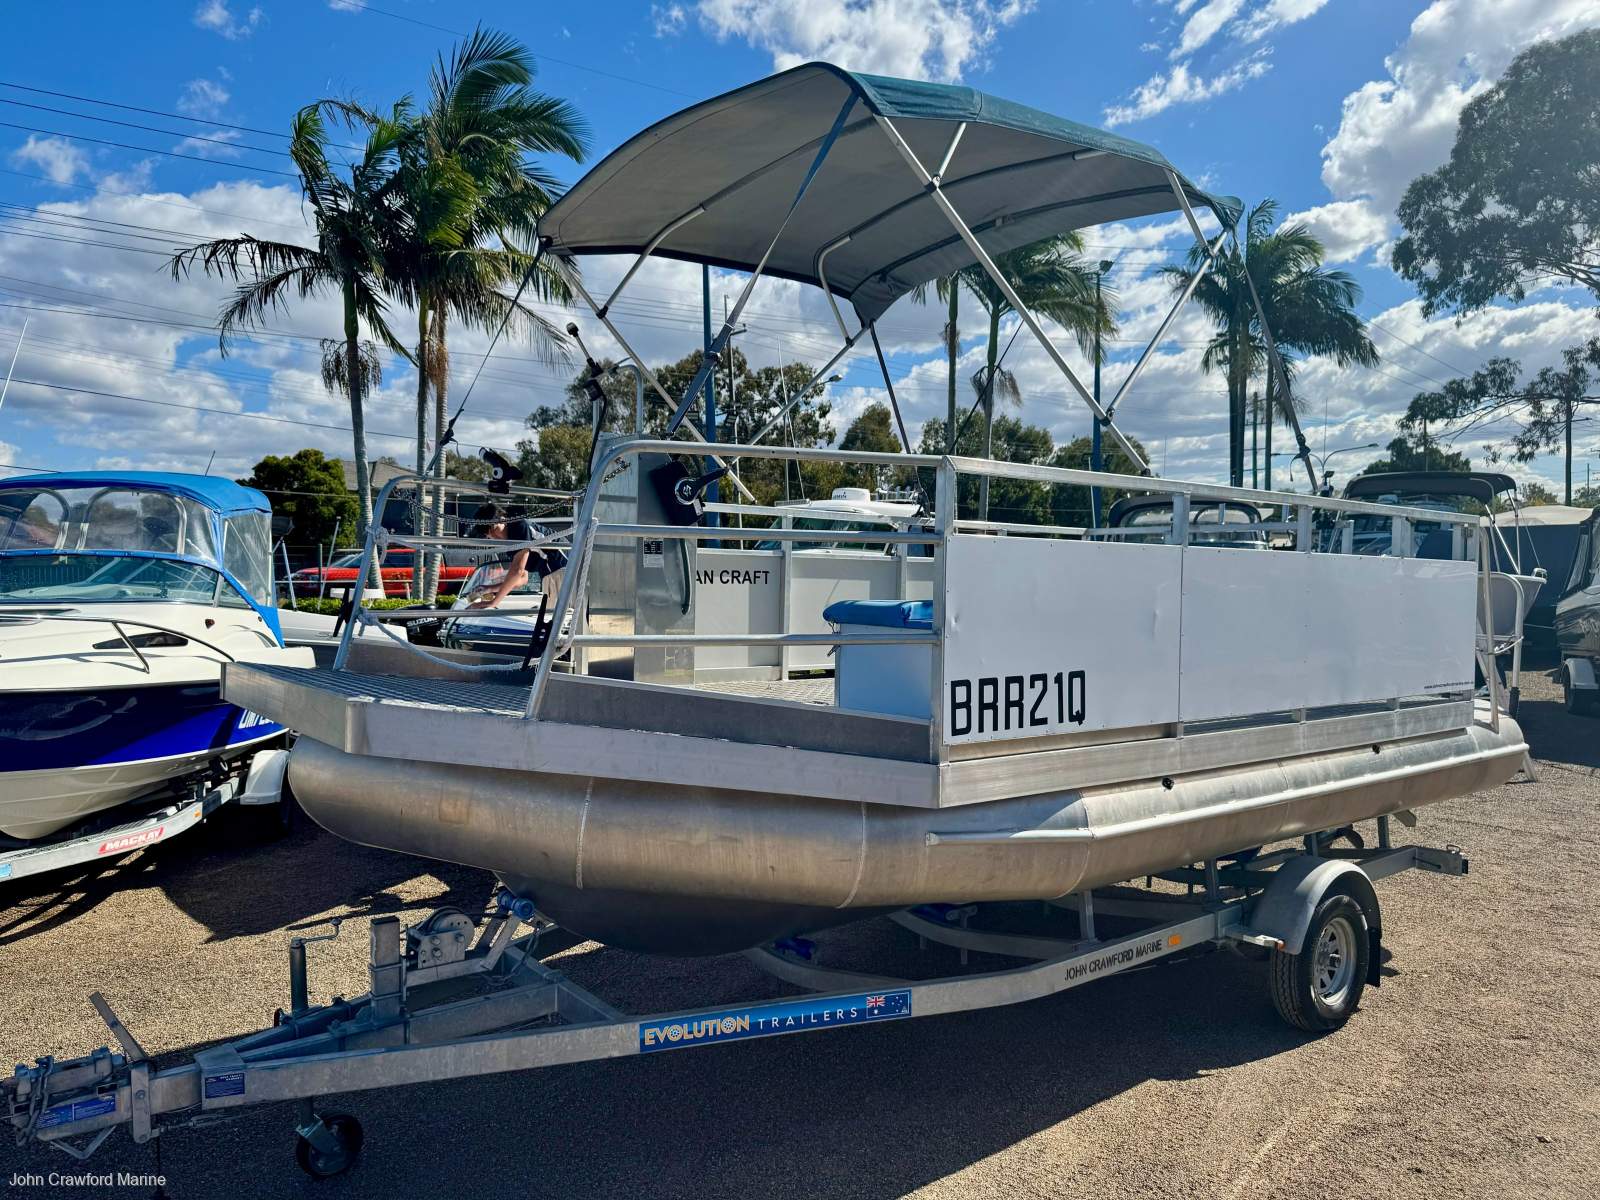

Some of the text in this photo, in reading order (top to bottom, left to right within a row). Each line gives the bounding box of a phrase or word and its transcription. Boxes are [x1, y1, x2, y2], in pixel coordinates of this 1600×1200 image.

[720, 569, 770, 585] CRAFT
[950, 670, 1086, 736] BRR21Q
[105, 830, 162, 851] MACKAY
[1064, 939, 1162, 980] JOHN CRAWFORD MARINE
[644, 1007, 858, 1046] EVOLUTION TRAILERS
